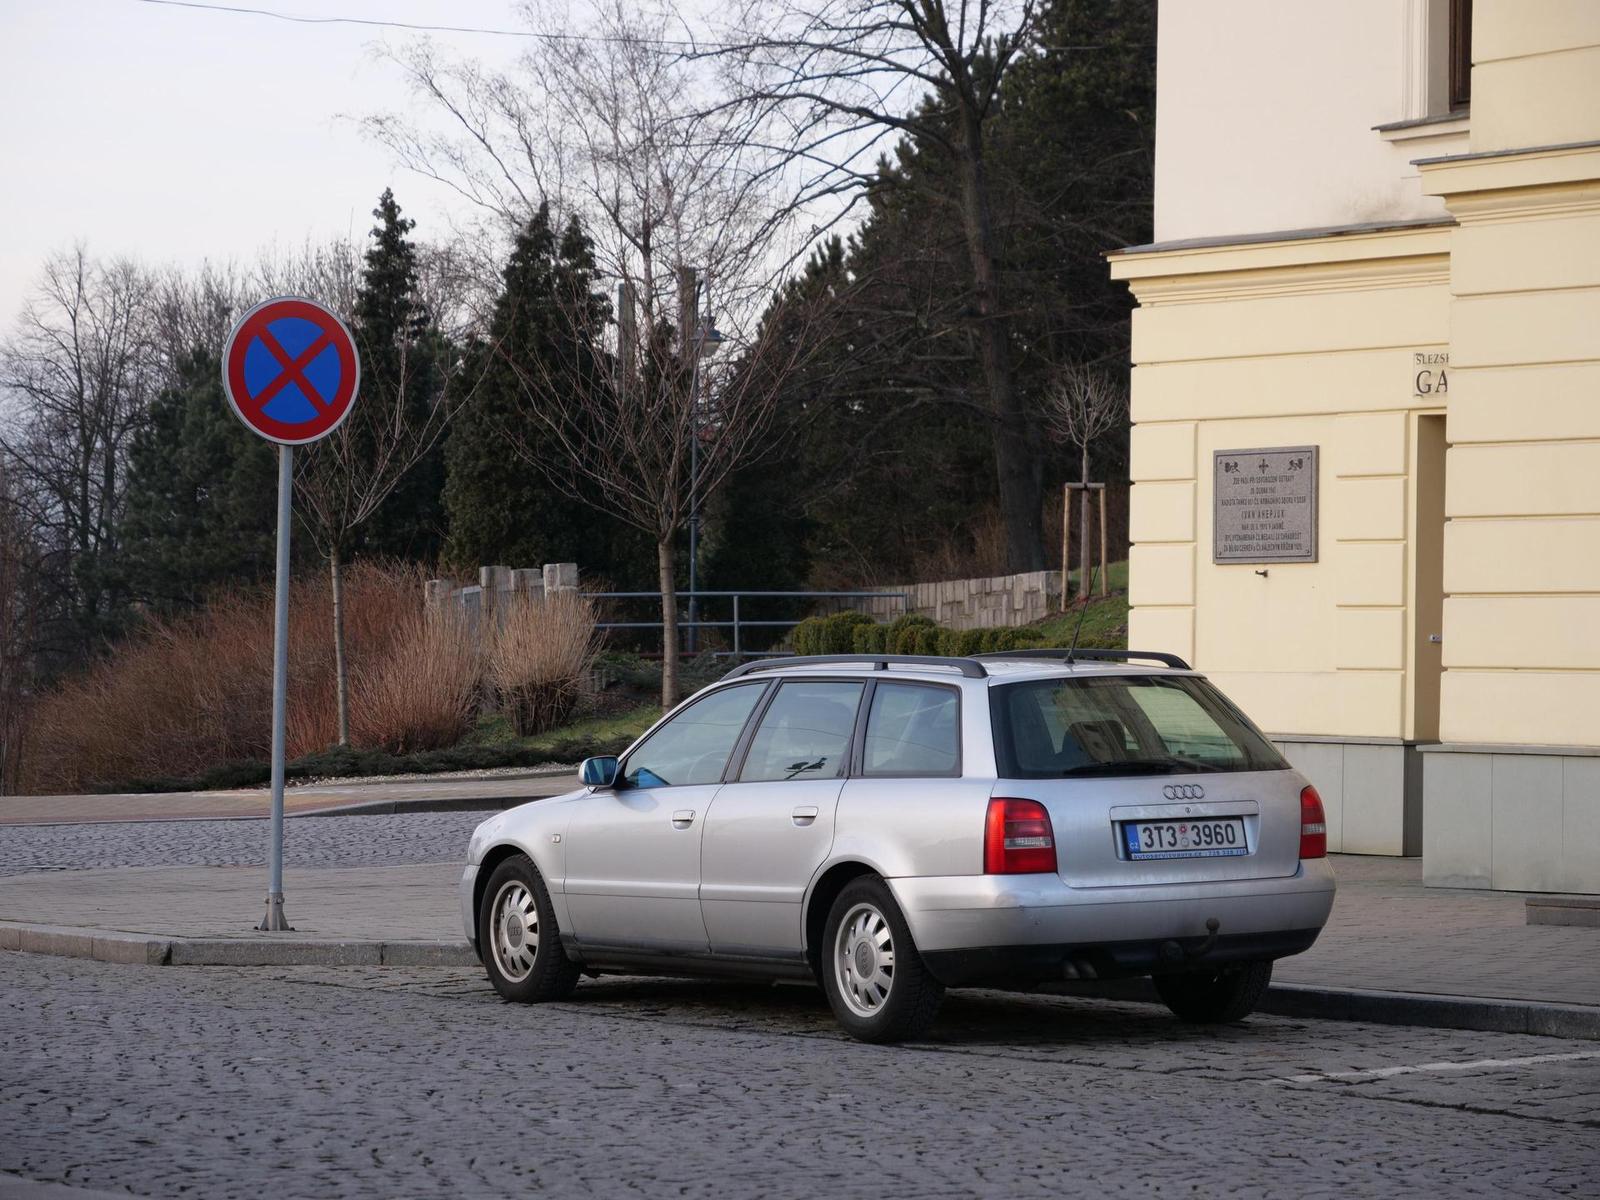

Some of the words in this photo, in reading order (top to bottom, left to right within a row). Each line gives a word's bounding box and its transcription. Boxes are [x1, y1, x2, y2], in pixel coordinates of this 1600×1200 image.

[1416, 369, 1448, 394] GA
[1129, 841, 1139, 850] CZ
[1142, 825, 1178, 849] 3T3
[1190, 823, 1236, 846] 3960
